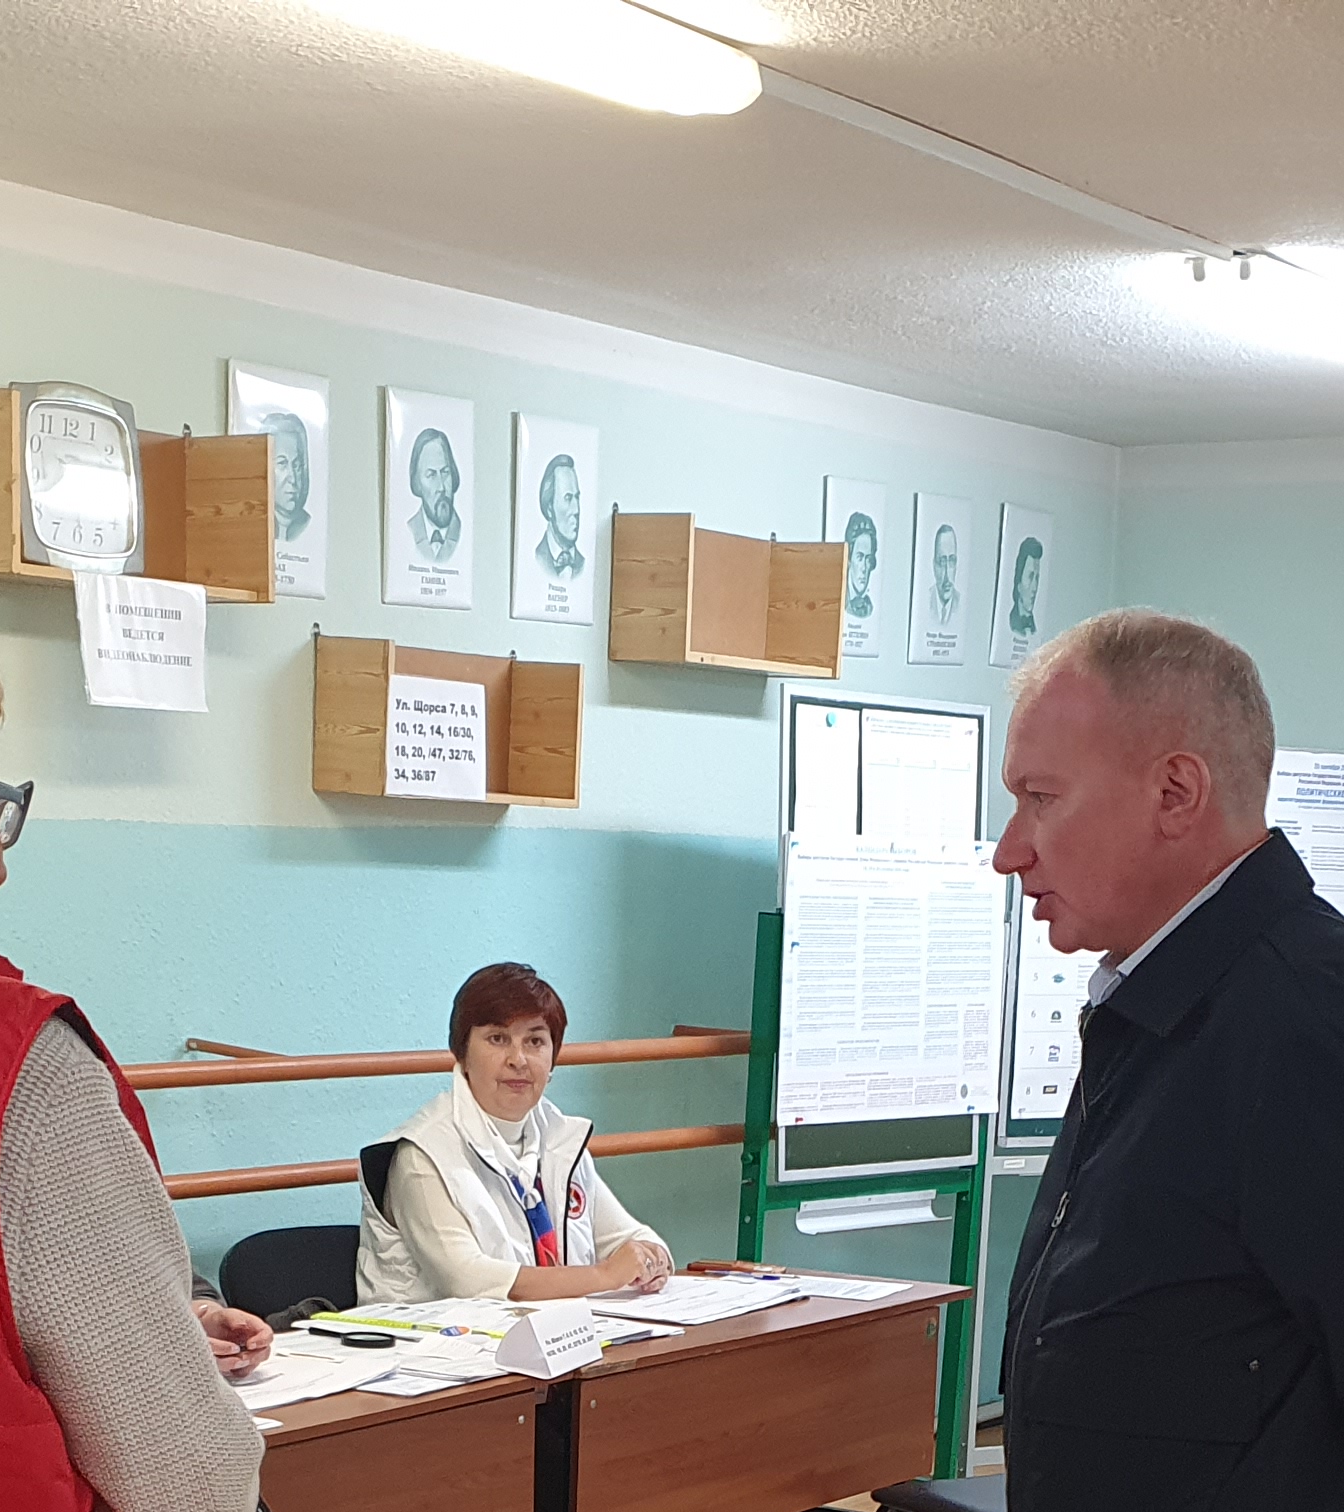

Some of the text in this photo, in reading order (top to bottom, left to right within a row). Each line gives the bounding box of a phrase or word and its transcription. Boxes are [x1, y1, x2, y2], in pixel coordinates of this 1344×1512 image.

[39, 413, 96, 441] 11 12 1
[72, 520, 83, 545] 6
[92, 527, 103, 547] 5
[395, 698, 478, 718] Ул. Щорса 7, 8, 9,
[395, 722, 474, 741] 10, 12, 14, 16/30,
[395, 745, 409, 759] 18,
[411, 746, 426, 760] 20,
[394, 768, 409, 782] 34,
